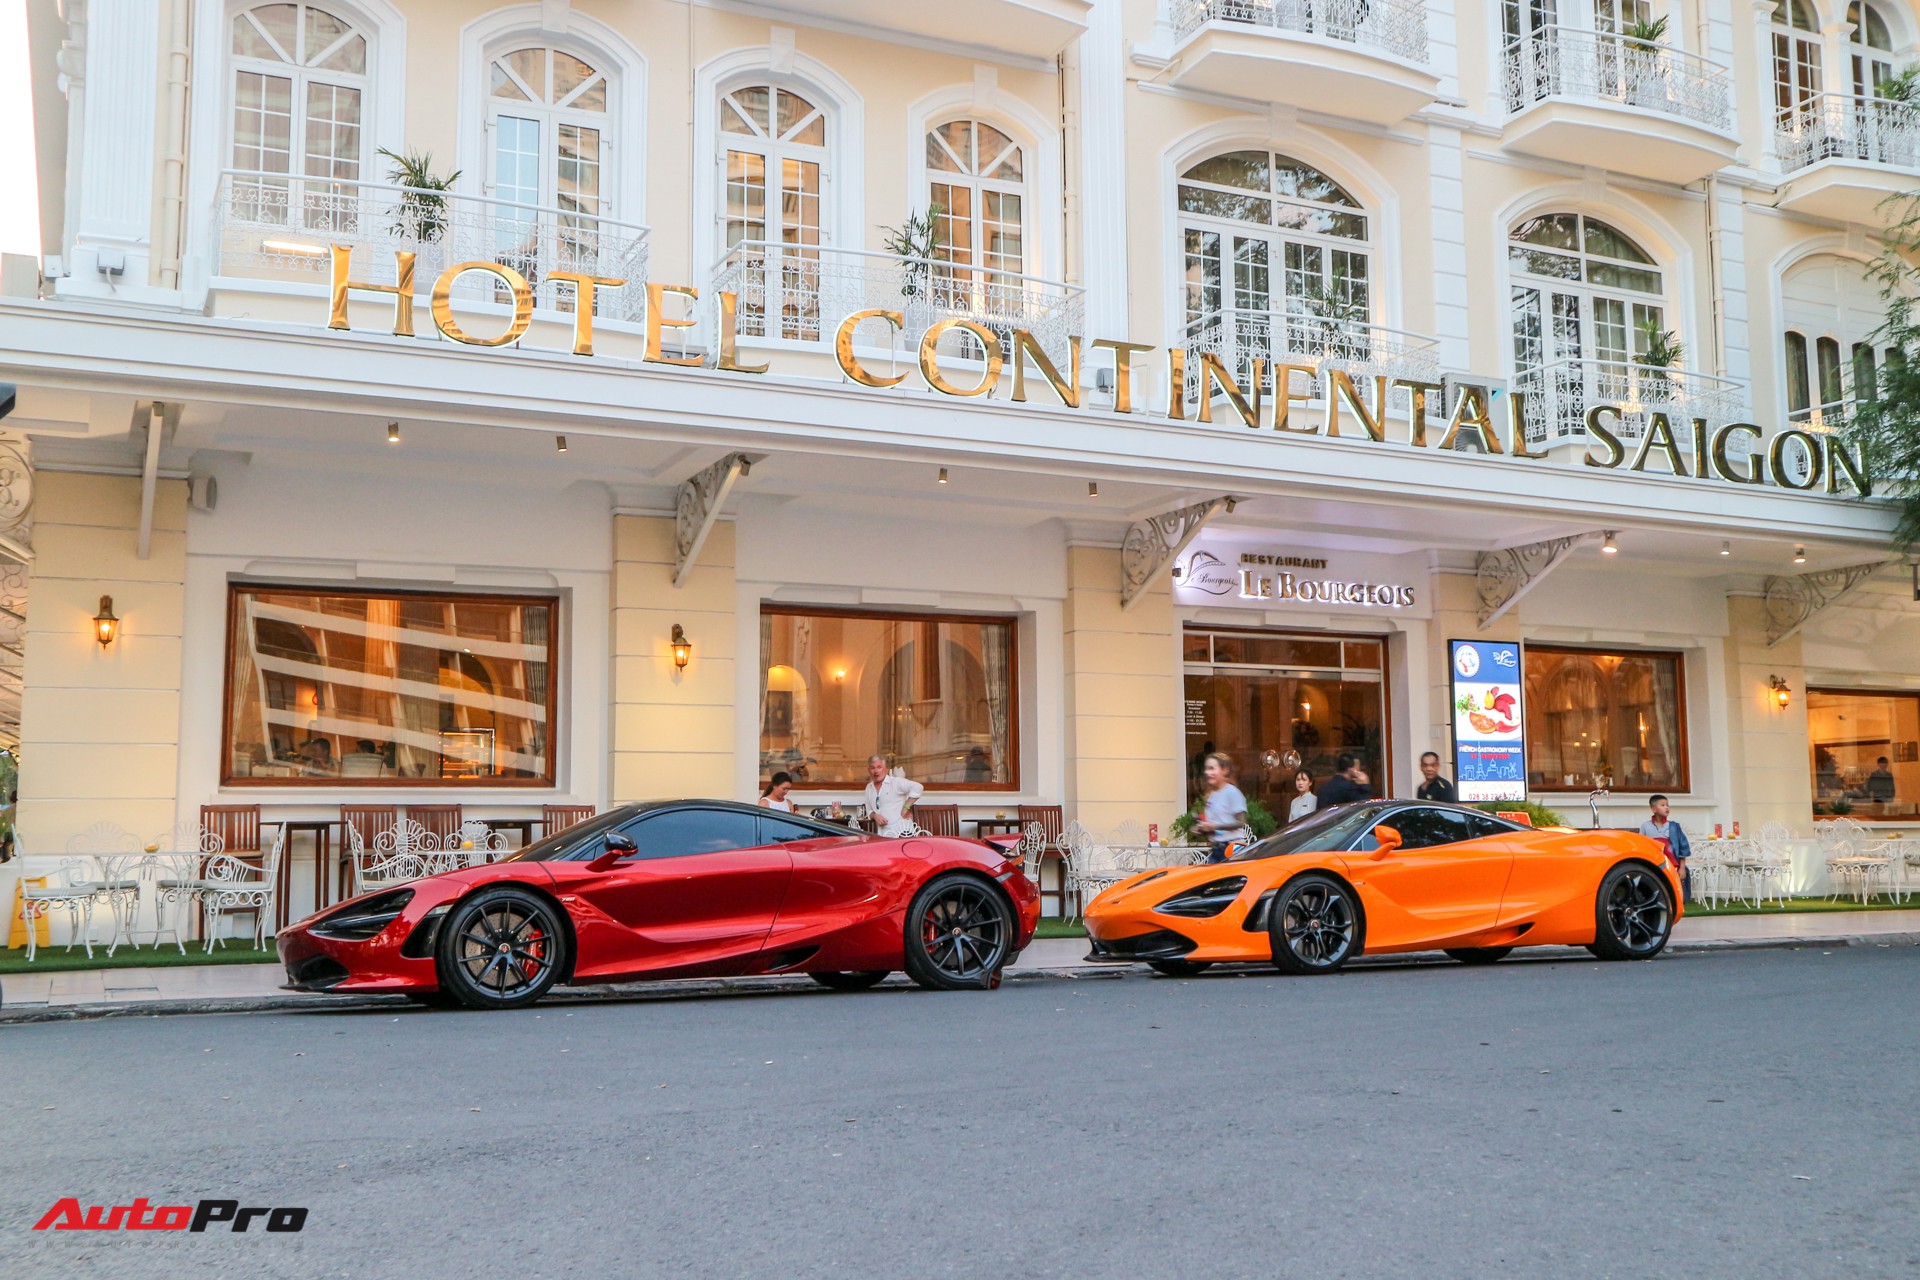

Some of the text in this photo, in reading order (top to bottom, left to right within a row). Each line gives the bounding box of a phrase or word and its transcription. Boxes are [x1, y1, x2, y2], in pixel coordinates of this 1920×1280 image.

[327, 243, 1873, 497] HOTEL CONTINENTAL SAIGON
[1240, 552, 1329, 569] RESTAURANT
